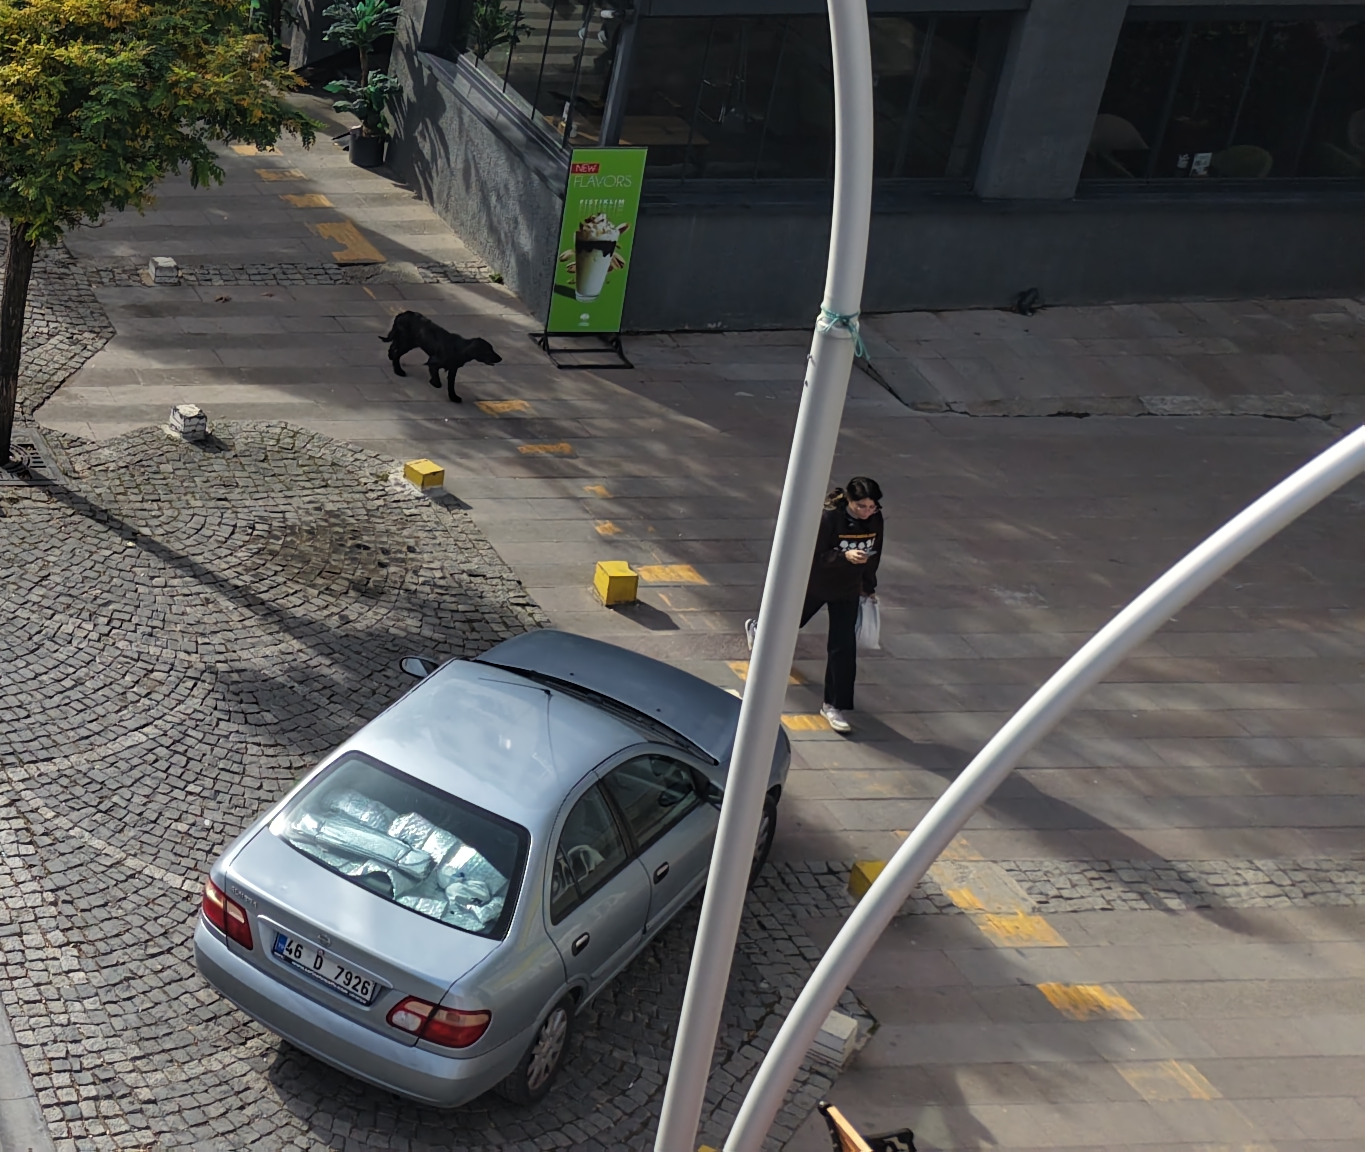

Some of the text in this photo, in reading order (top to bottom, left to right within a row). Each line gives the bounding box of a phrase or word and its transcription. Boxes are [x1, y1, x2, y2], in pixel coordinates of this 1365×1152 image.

[575, 163, 597, 173] NEW
[573, 174, 632, 189] FLAVORS
[285, 939, 304, 959] 46
[334, 965, 371, 996] 7926
